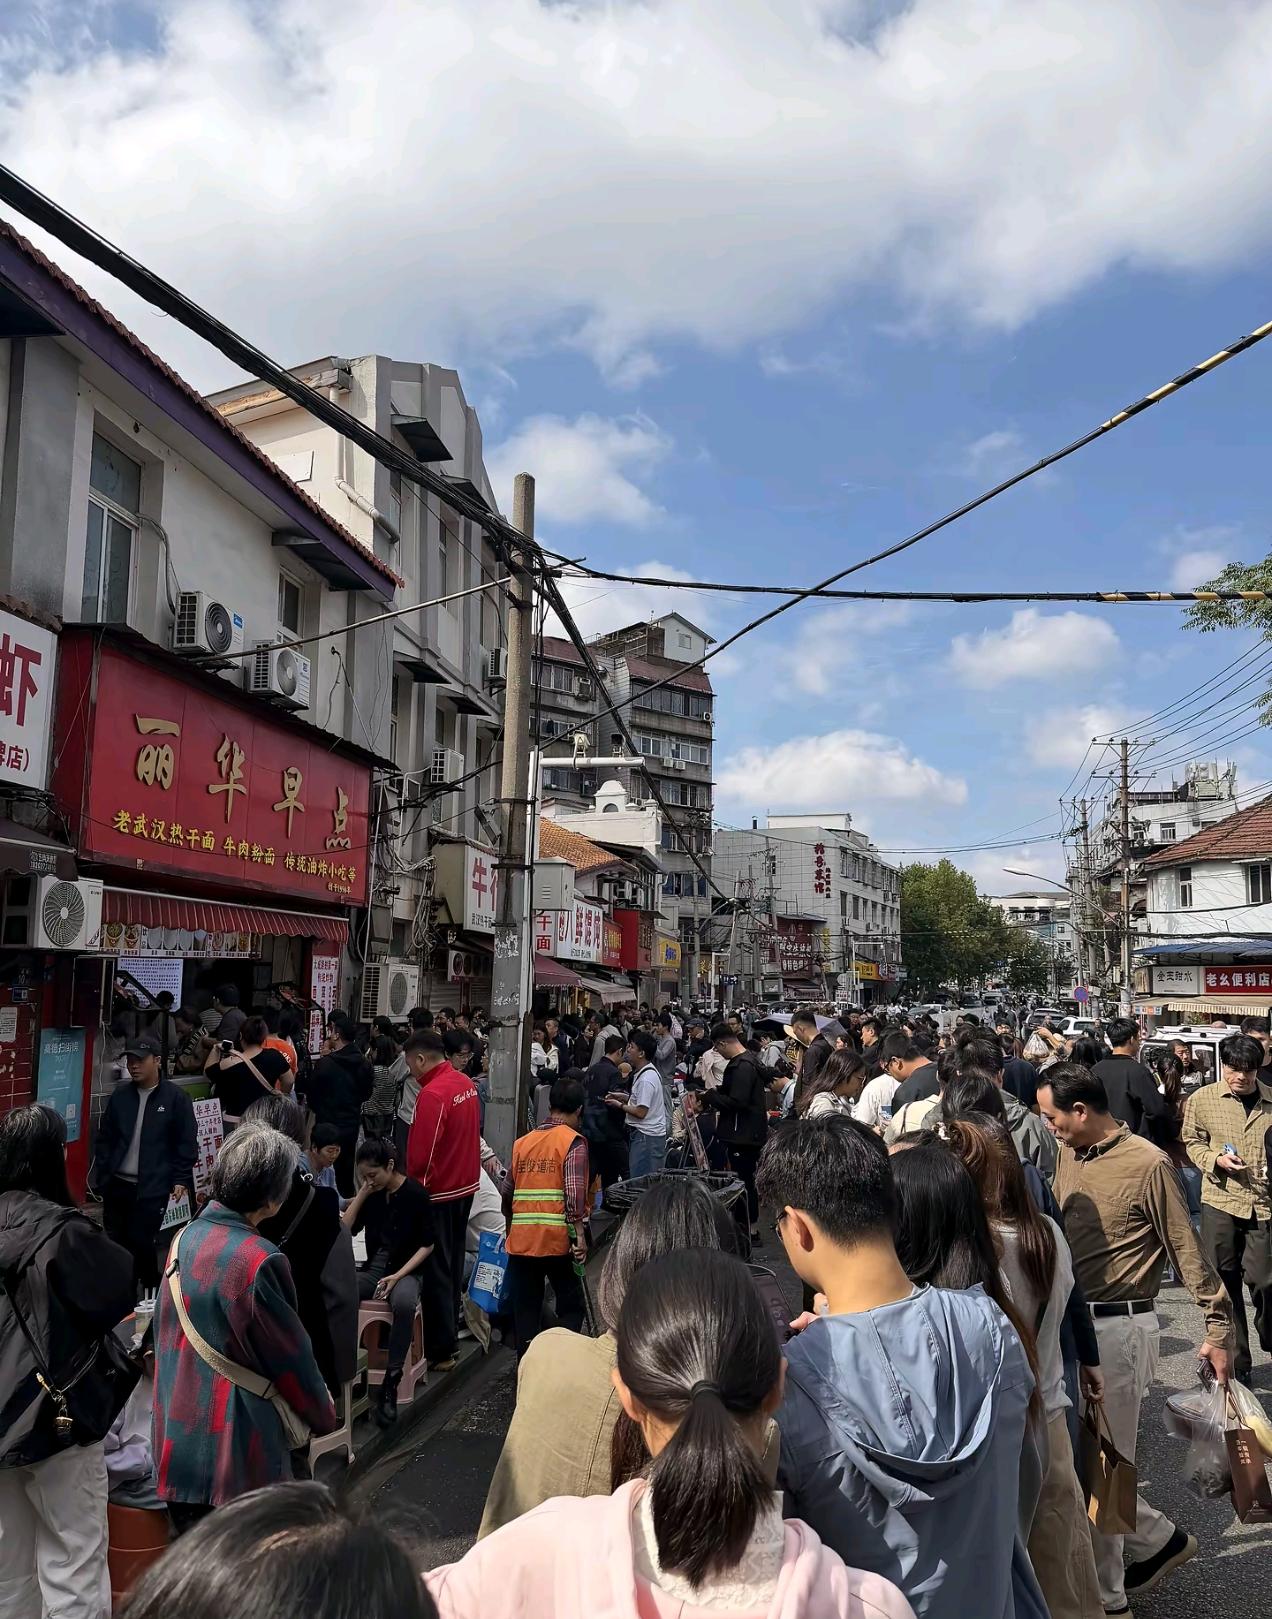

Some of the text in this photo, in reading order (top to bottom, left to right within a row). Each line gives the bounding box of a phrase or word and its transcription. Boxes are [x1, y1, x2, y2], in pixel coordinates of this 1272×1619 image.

[135, 713, 350, 849] 丽华早点
[113, 809, 356, 883] 老武汉热干面 牛肉粉面 传统油炸小吃等
[1206, 972, 1270, 987] 老幺便利店
